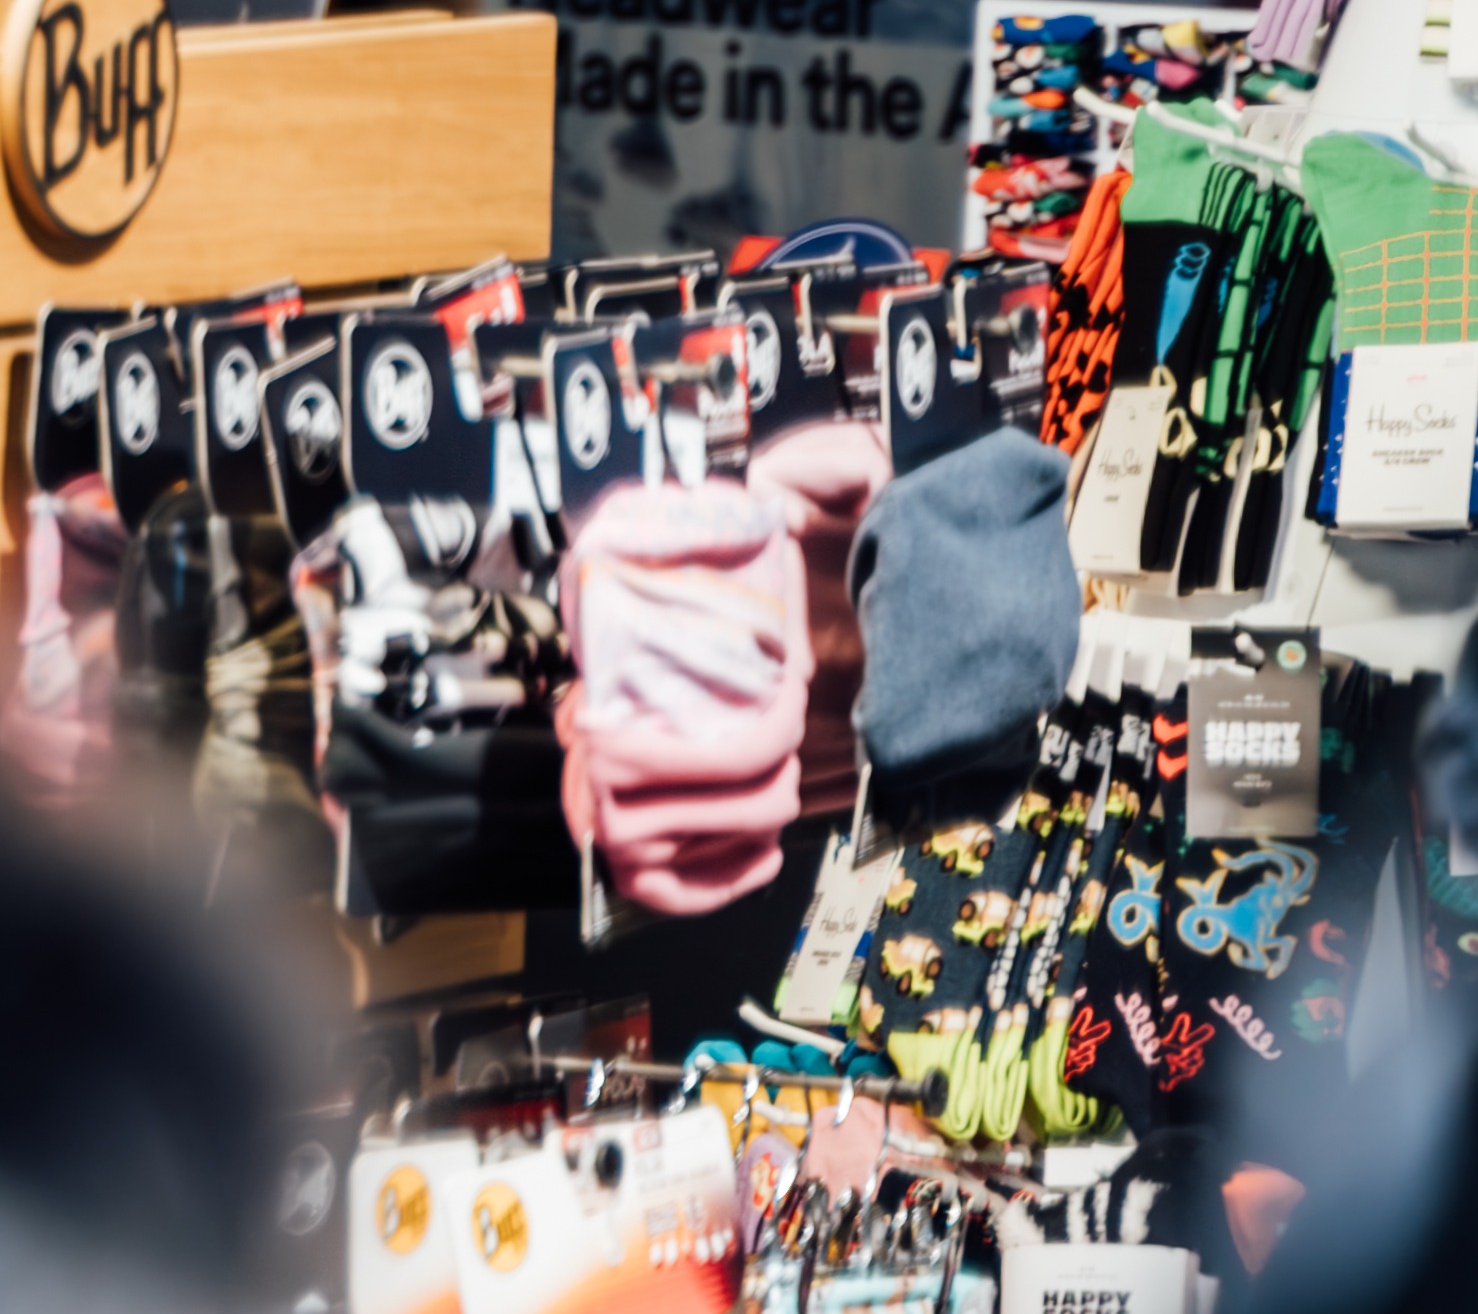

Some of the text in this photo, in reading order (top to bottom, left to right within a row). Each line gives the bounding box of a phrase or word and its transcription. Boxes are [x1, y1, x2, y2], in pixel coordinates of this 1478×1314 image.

[556, 27, 705, 123] ade
[720, 39, 786, 131] in
[802, 47, 924, 142] the
[1365, 404, 1413, 437] Happy
[1042, 1289, 1132, 1307] HAPPY
